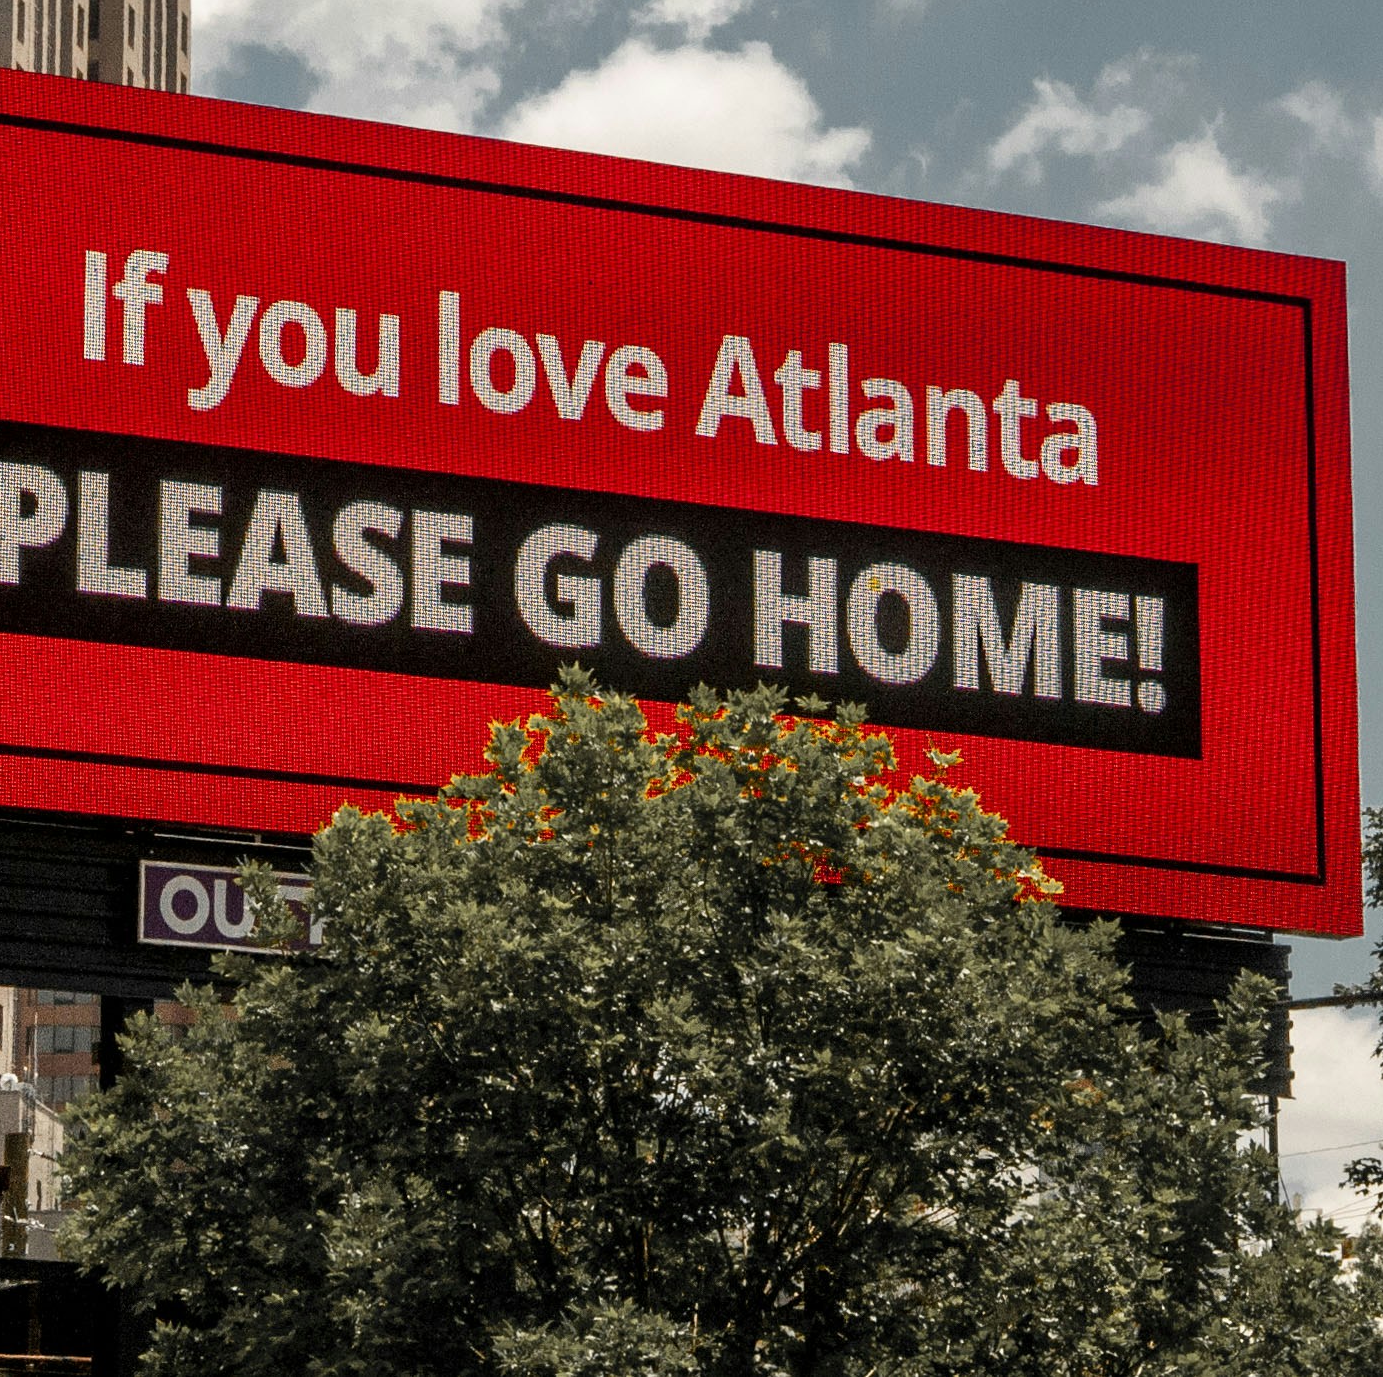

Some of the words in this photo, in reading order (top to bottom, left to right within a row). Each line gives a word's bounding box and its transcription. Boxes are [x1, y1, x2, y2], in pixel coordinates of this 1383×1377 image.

[83, 249, 170, 366] If
[186, 287, 401, 411] you
[439, 290, 669, 432] love
[695, 334, 1100, 486] Atlanta
[514, 523, 711, 659] GO
[752, 549, 1168, 714] HOME!
